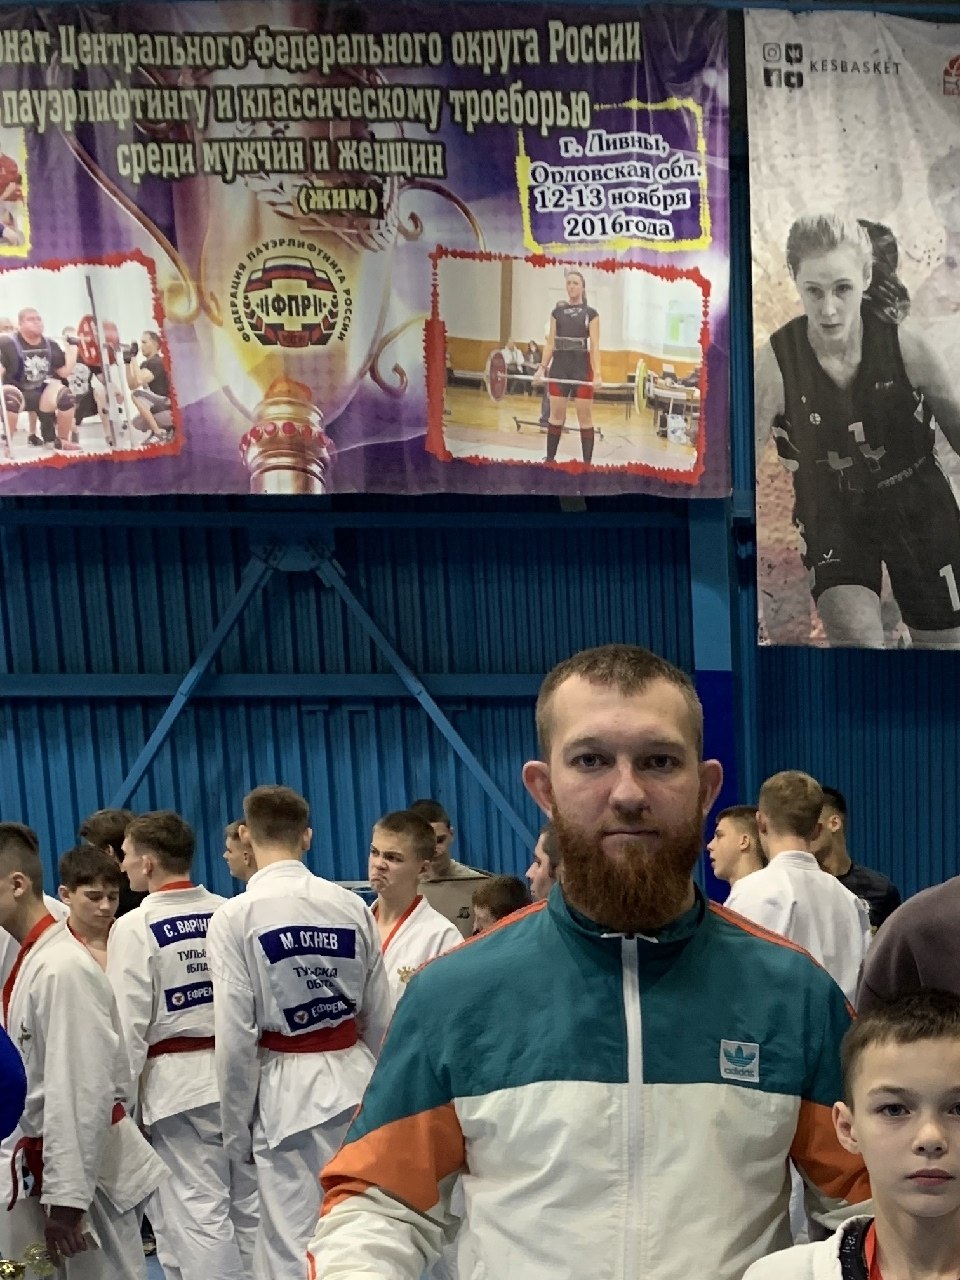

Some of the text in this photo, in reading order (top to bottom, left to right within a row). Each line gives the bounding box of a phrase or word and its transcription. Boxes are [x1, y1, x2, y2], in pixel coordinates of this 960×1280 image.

[0, 20, 642, 75] нат Центрального Федерального округа России
[809, 58, 903, 76] KESBASKET
[2, 80, 592, 137] пауэрлифтингу и классическому троеборью
[563, 132, 668, 154] г. Ливны,
[117, 140, 445, 184] среди мужчин и женщин
[531, 156, 702, 185] Орловская обл.
[299, 188, 378, 214] (жим)
[537, 187, 688, 212] 12-13 ноября
[566, 216, 671, 238] 2016года
[230, 238, 353, 342] ФЕДЕРАЦИЯ ПАУЭРЛИФТИНГА РОССИИ
[271, 294, 312, 317] ФПР
[279, 931, 299, 950] М.
[724, 1067, 755, 1078] adidas
